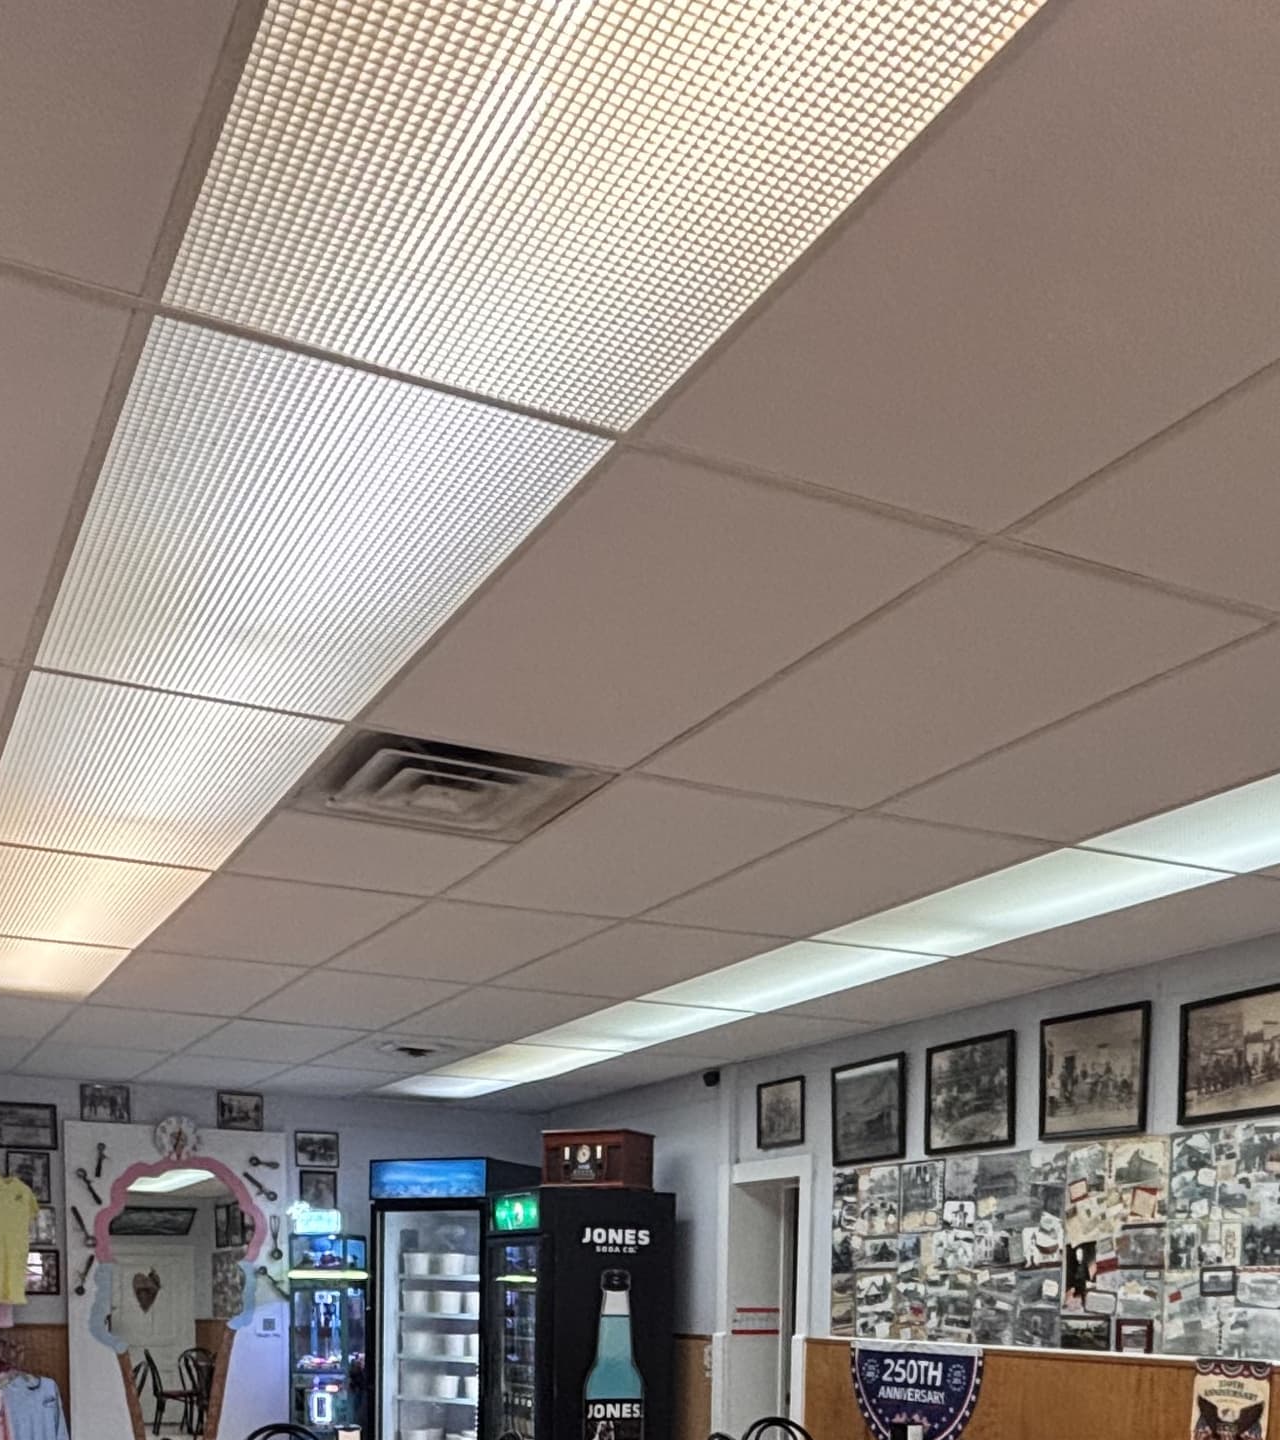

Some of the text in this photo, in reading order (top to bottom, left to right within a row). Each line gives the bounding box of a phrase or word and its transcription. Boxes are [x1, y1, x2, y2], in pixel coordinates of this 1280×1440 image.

[581, 1227, 651, 1246] JONES
[595, 1245, 621, 1254] SODA
[881, 1358, 944, 1388] 250TH
[878, 1385, 946, 1406] ANNIVERSARY
